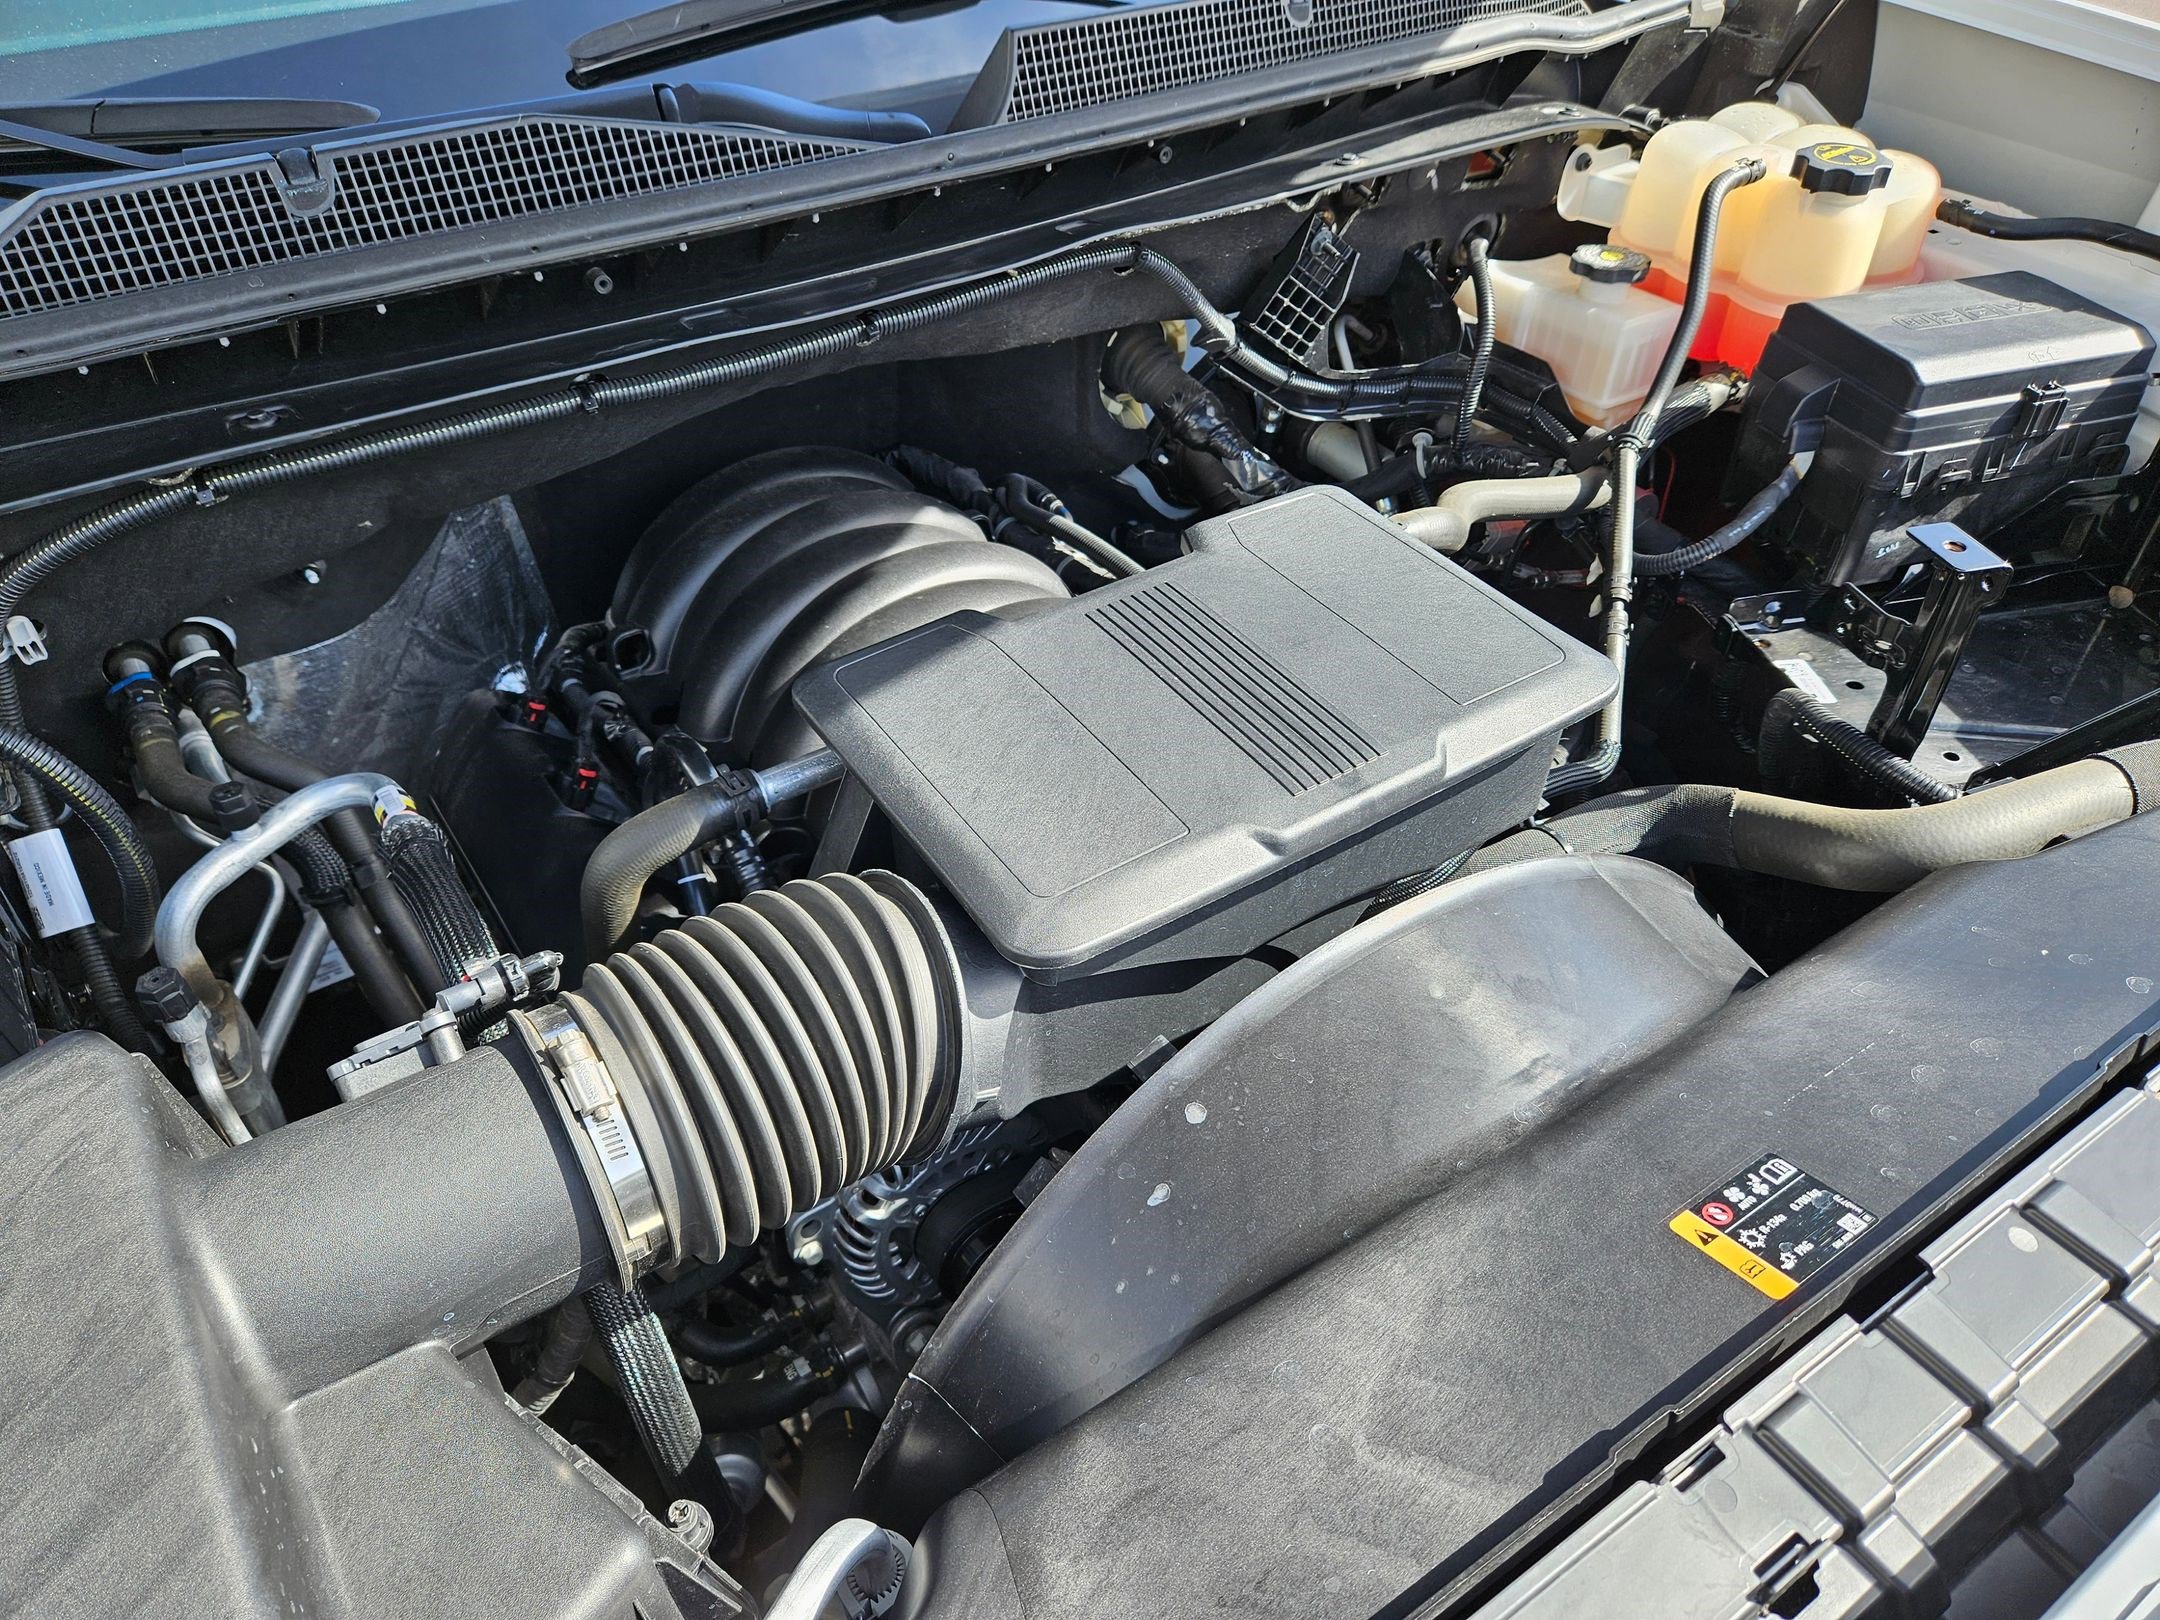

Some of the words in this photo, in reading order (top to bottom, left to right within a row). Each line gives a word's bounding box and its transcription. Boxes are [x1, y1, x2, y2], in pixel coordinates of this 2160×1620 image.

[33, 862, 45, 884] MEXICO
[1738, 1195, 1757, 1210] AUTO
[1759, 1213, 1788, 1235] R-134a
[1793, 1240, 1815, 1257] PAG
